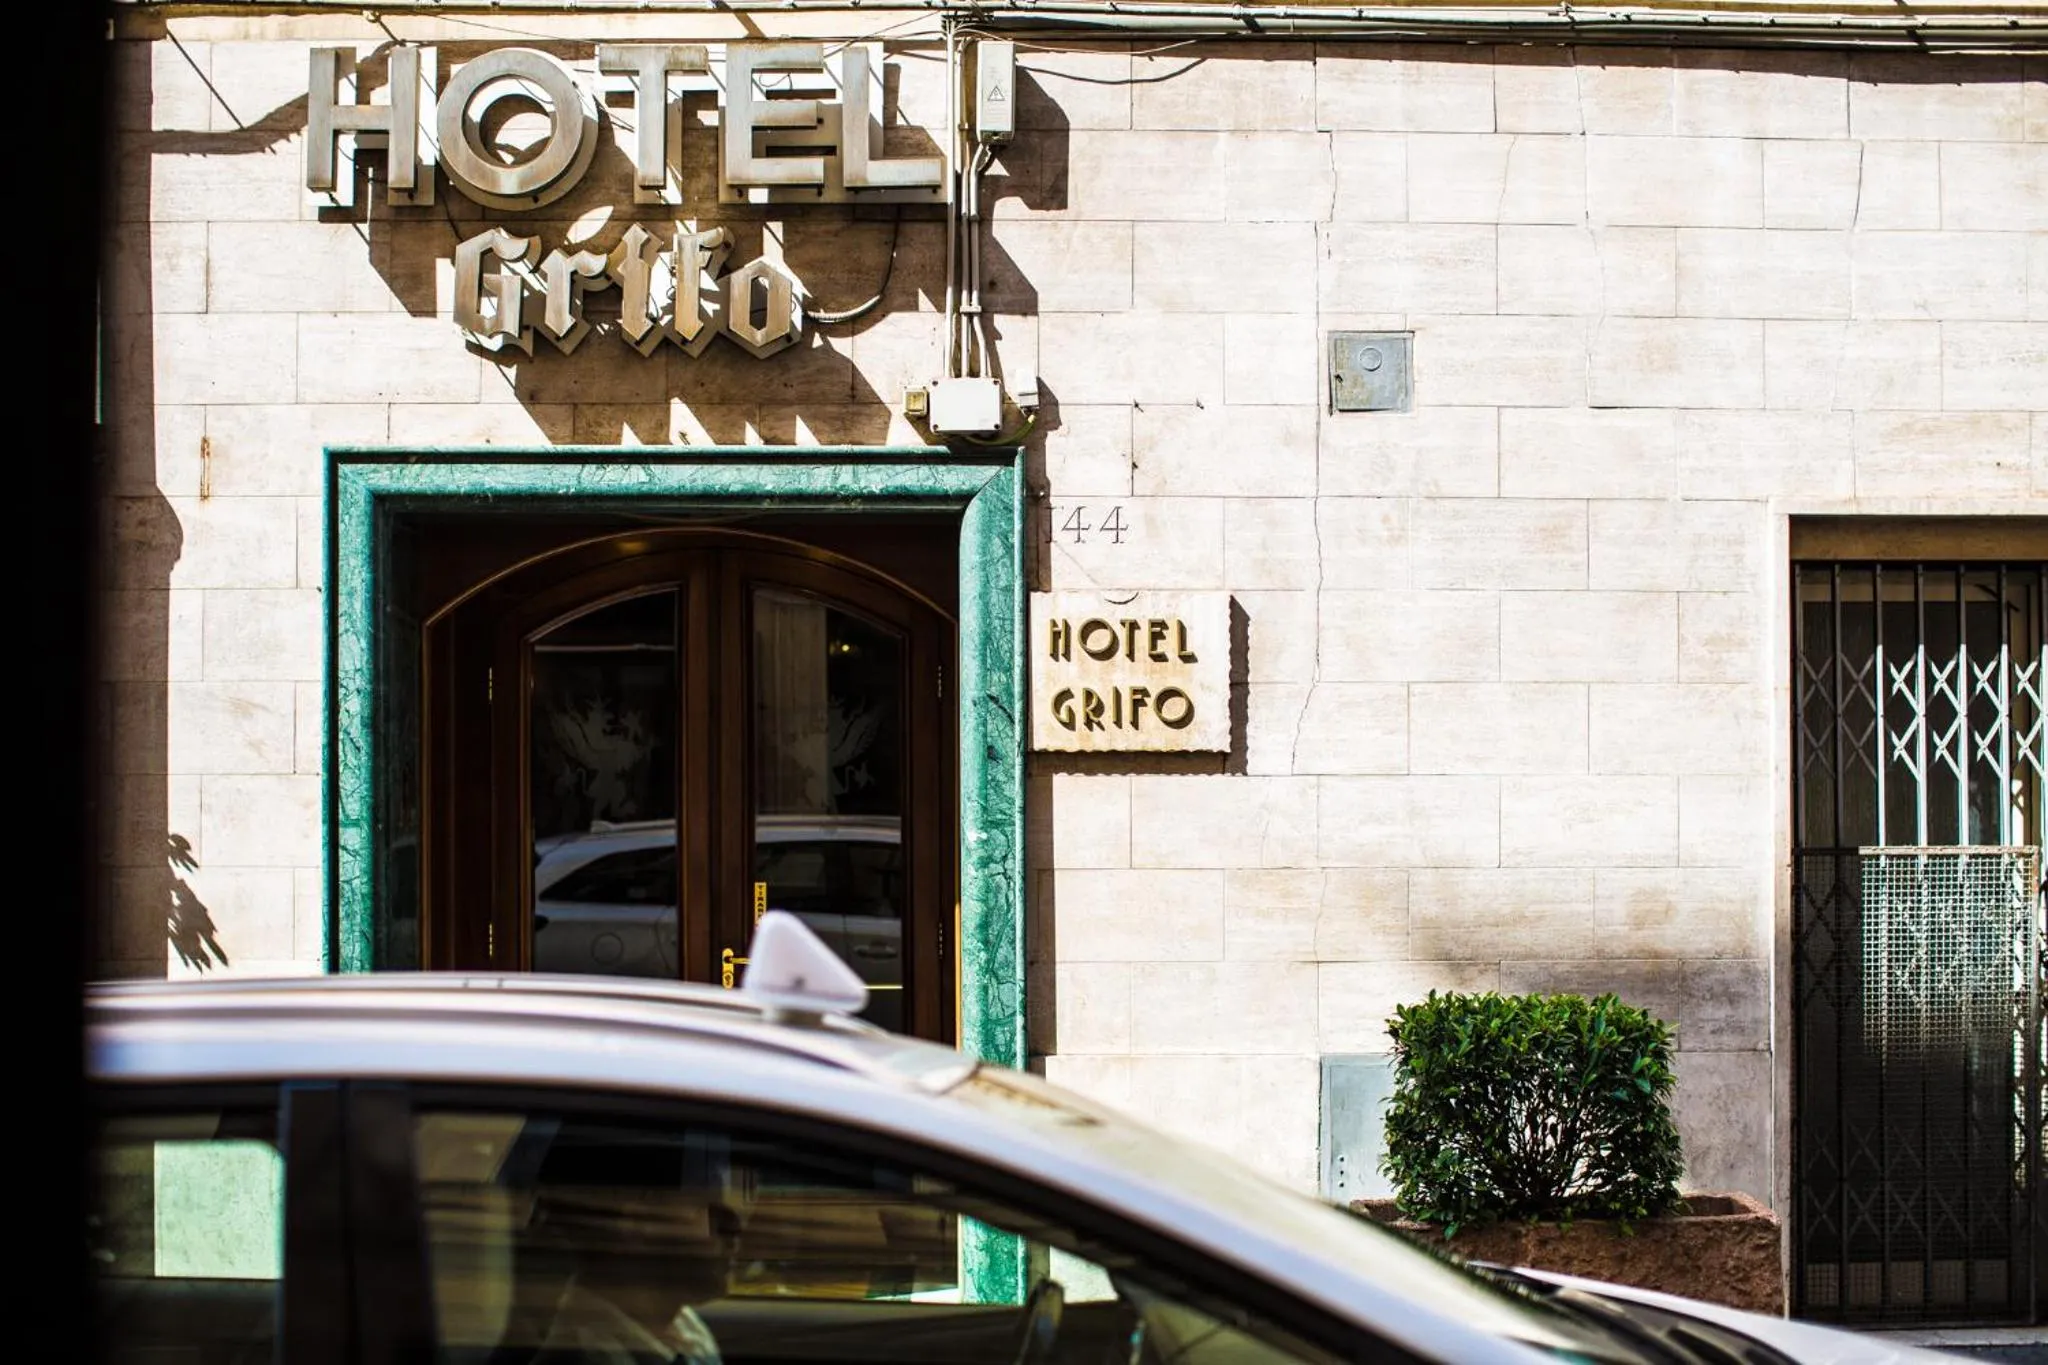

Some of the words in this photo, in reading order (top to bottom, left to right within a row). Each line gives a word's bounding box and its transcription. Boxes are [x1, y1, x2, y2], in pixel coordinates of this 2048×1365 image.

[306, 44, 944, 206] HOTEL
[453, 222, 801, 357] Grifo
[1045, 505, 1129, 544] 144
[1050, 618, 1198, 663] HOTEL
[1052, 686, 1195, 731] GRIFO
